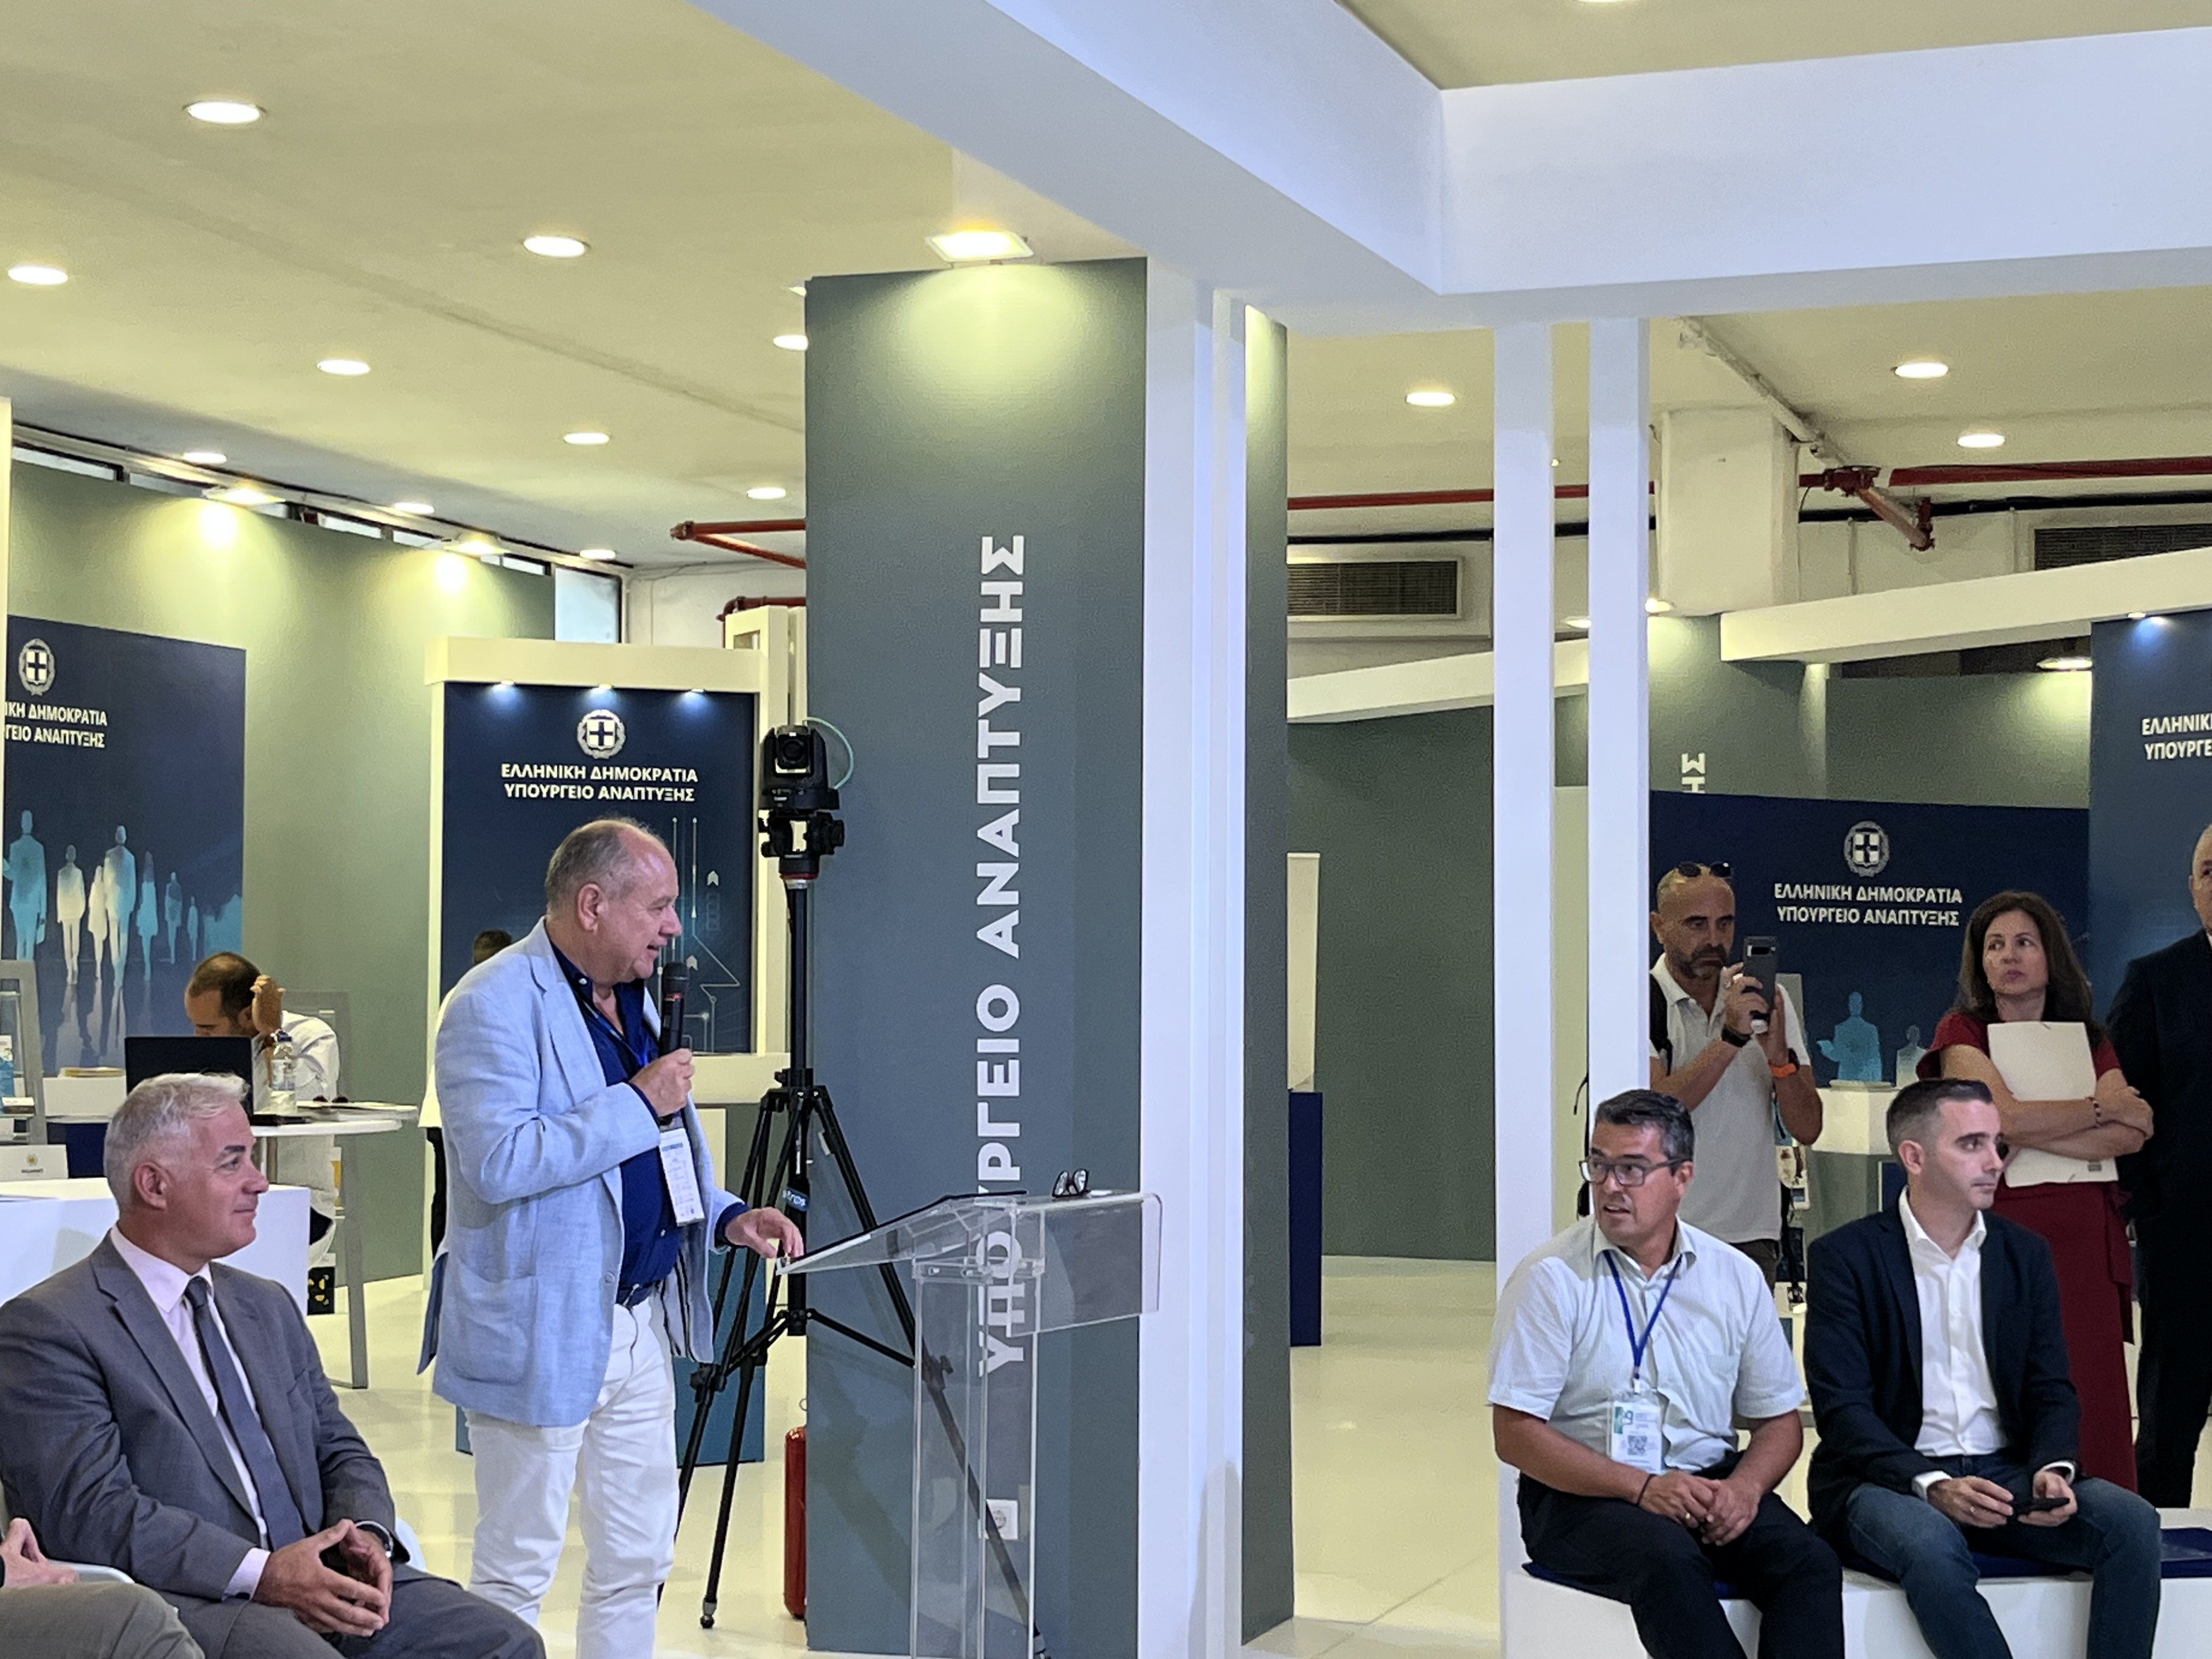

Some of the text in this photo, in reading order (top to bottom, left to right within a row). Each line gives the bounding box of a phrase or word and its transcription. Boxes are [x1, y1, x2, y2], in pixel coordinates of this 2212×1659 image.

[28, 703, 108, 726] ΔΗΜΟΚΡΑΤΙΑ
[2142, 713, 2212, 735] ΕΛΛΗΝΙΚ
[33, 727, 105, 748] ΑΝΑΠΤΥΞΗΣ
[977, 535, 1025, 959] ΑΝΑΠΤΥΞΗΣ
[2144, 740, 2212, 760] ΥΠΟΥΡΓΕ
[501, 763, 698, 782] ΕΛΛΗΝΙΚΗ ΔΗΜΟΚΡΑΤΙΑ
[504, 783, 695, 802] ΥΠΟΥΡΓΕΙΟ ΑΝΑΠΤΥΞΗΣ
[1774, 883, 1963, 904] ΕΛΛΗΝΙΚΗ ΔΗΜΟΚΡΑΤΙΑ
[1777, 906, 1960, 926] ΥΠΟΥΡΓΕΙΟ ΑΝΑΠΤΥΞΗΣ
